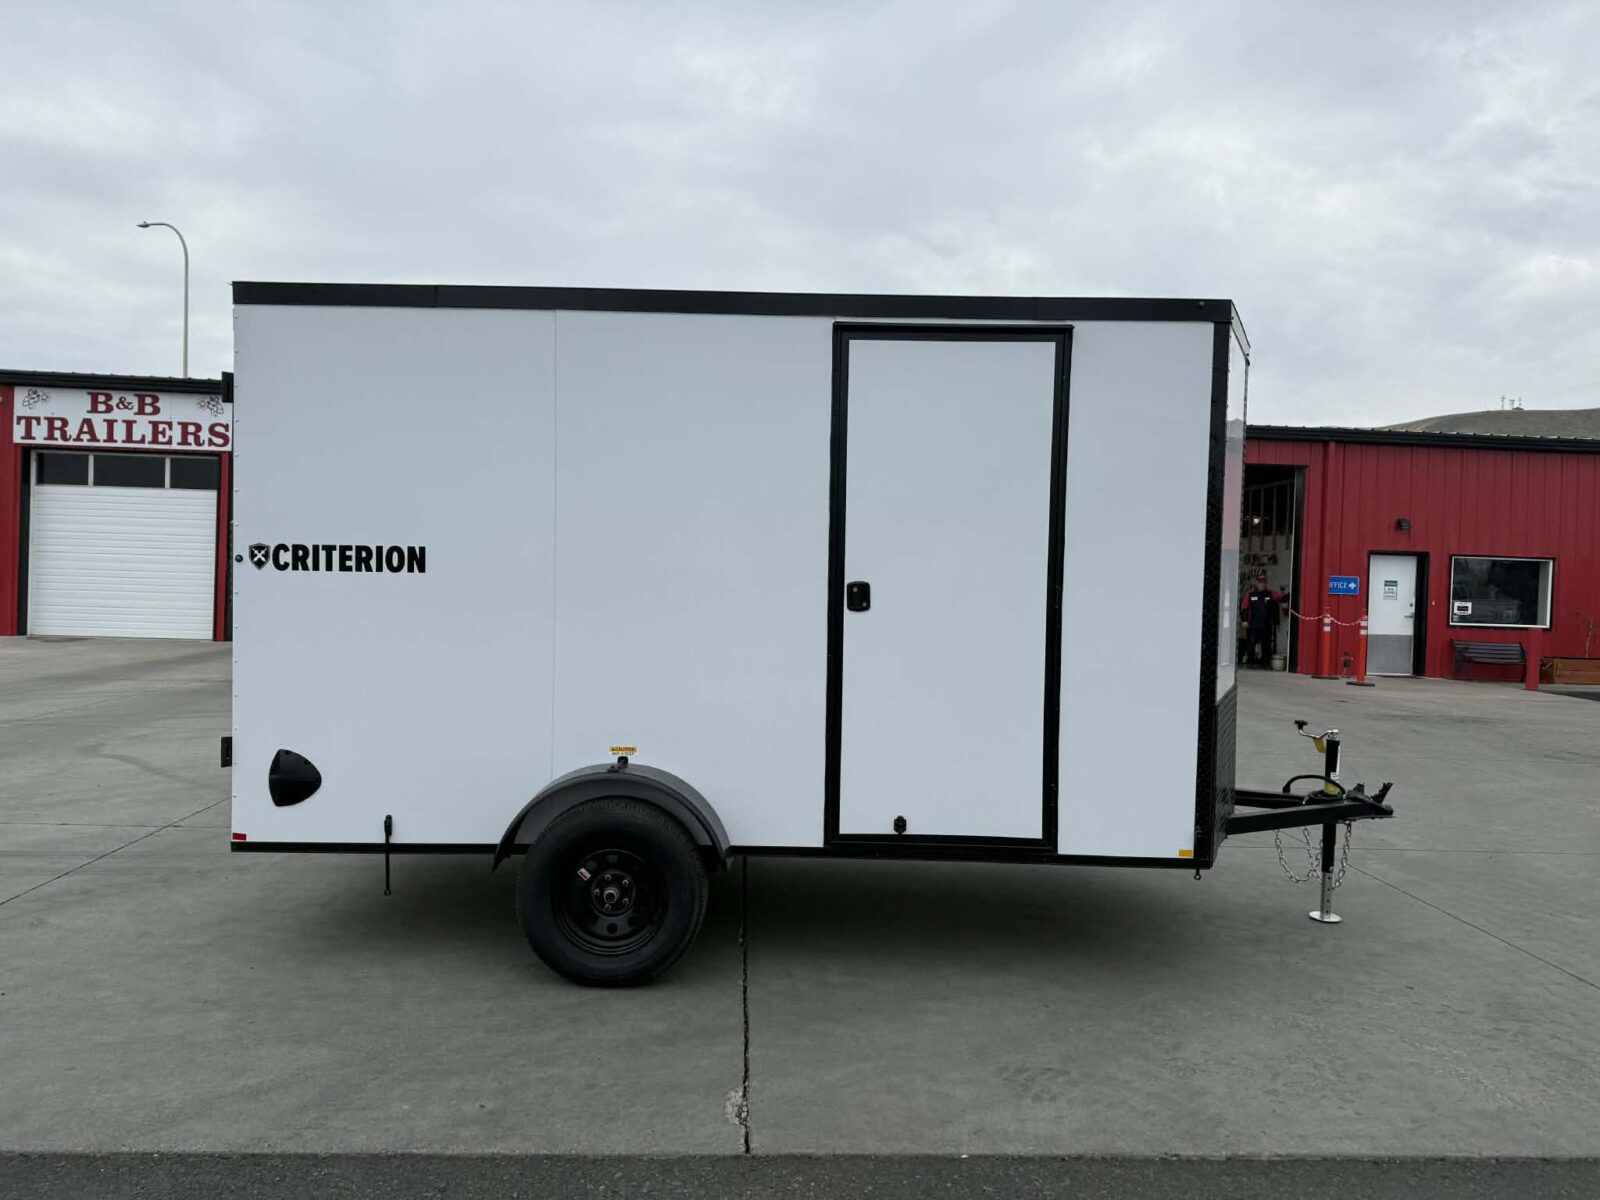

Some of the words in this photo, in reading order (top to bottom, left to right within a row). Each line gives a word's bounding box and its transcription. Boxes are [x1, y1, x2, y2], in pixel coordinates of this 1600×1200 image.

[87, 391, 161, 416] B&B
[16, 415, 230, 448] TRAILERS
[272, 543, 426, 573] CRITERION
